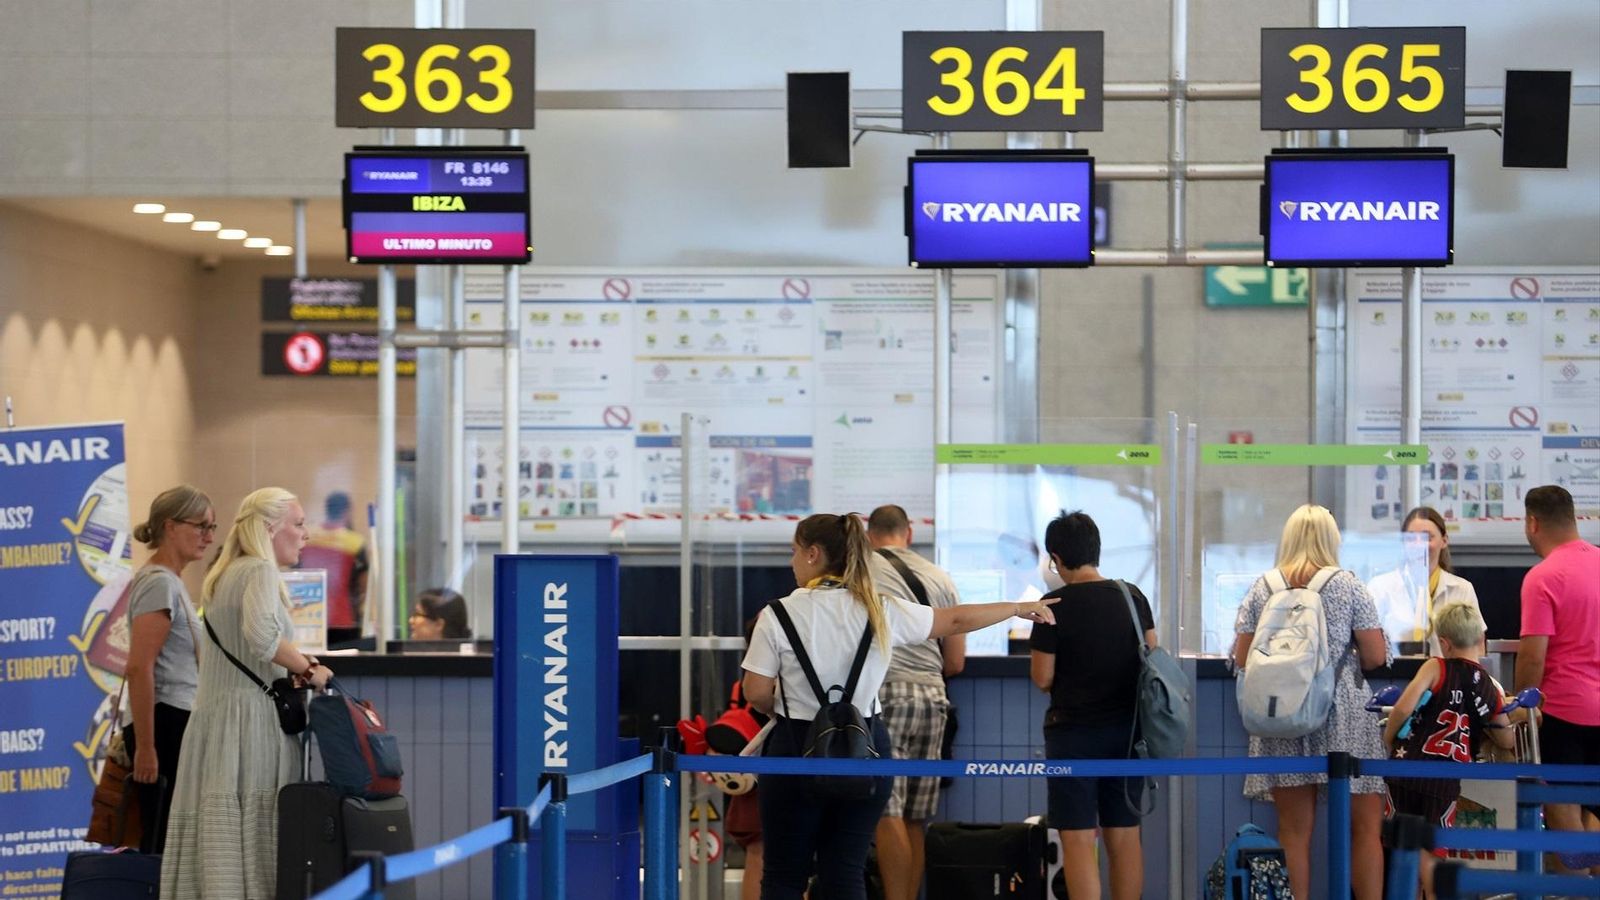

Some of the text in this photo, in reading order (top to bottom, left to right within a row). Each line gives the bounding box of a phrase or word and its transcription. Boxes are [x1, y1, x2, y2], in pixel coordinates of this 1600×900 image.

[359, 44, 513, 114] 363
[927, 47, 1086, 116] 364
[1285, 44, 1444, 114] 365
[444, 162, 509, 174] FR 8146
[412, 196, 466, 211] IBIZA
[942, 202, 1081, 222] RYANAIR
[1301, 201, 1440, 221] RYANAIR
[383, 238, 493, 250] ULTIMO MINUTO
[1396, 450, 1417, 459] aena
[0, 543, 72, 569] MBARQUE?
[0, 616, 55, 643] SPORT?
[543, 582, 568, 767] RYANAIR
[1422, 709, 1473, 763] 23
[5, 831, 24, 841] not
[26, 828, 55, 840] need
[57, 828, 70, 838] to
[1, 846, 14, 857] to
